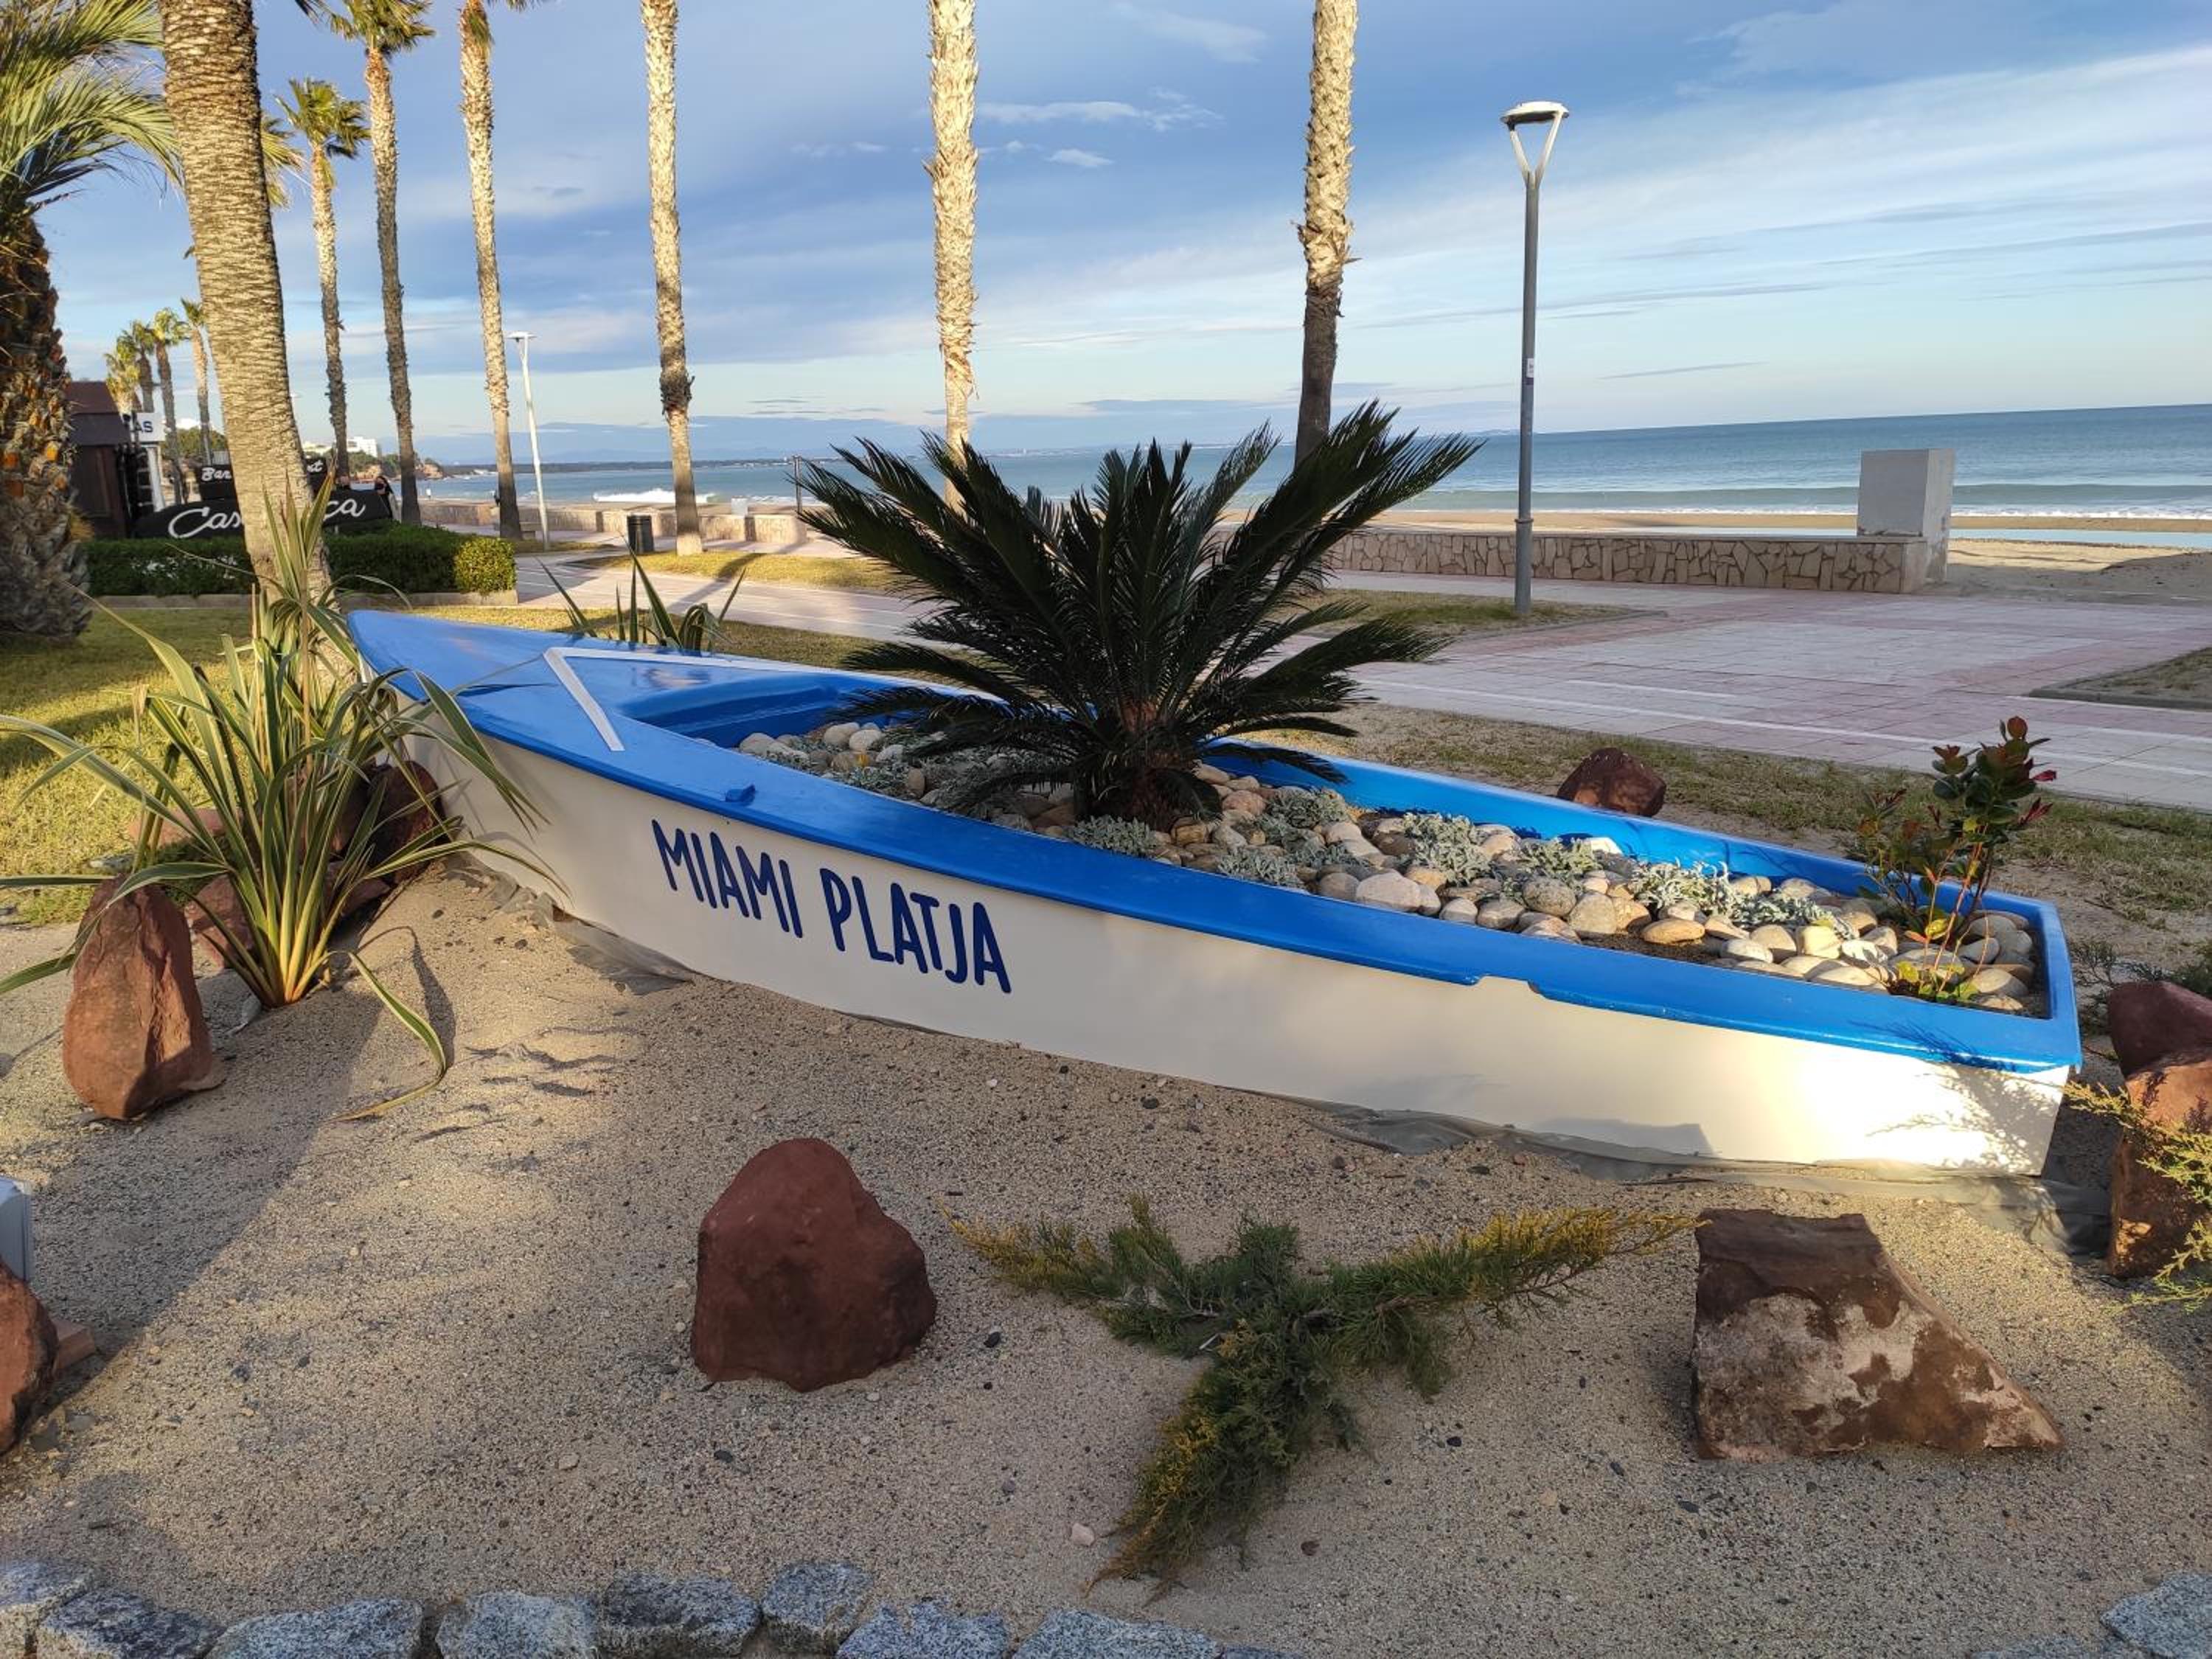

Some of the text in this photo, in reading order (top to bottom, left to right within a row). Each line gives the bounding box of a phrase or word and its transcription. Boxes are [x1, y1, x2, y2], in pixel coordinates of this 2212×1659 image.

[201, 467, 232, 481] Bar
[652, 819, 1012, 994] MIAMI PLATJA
